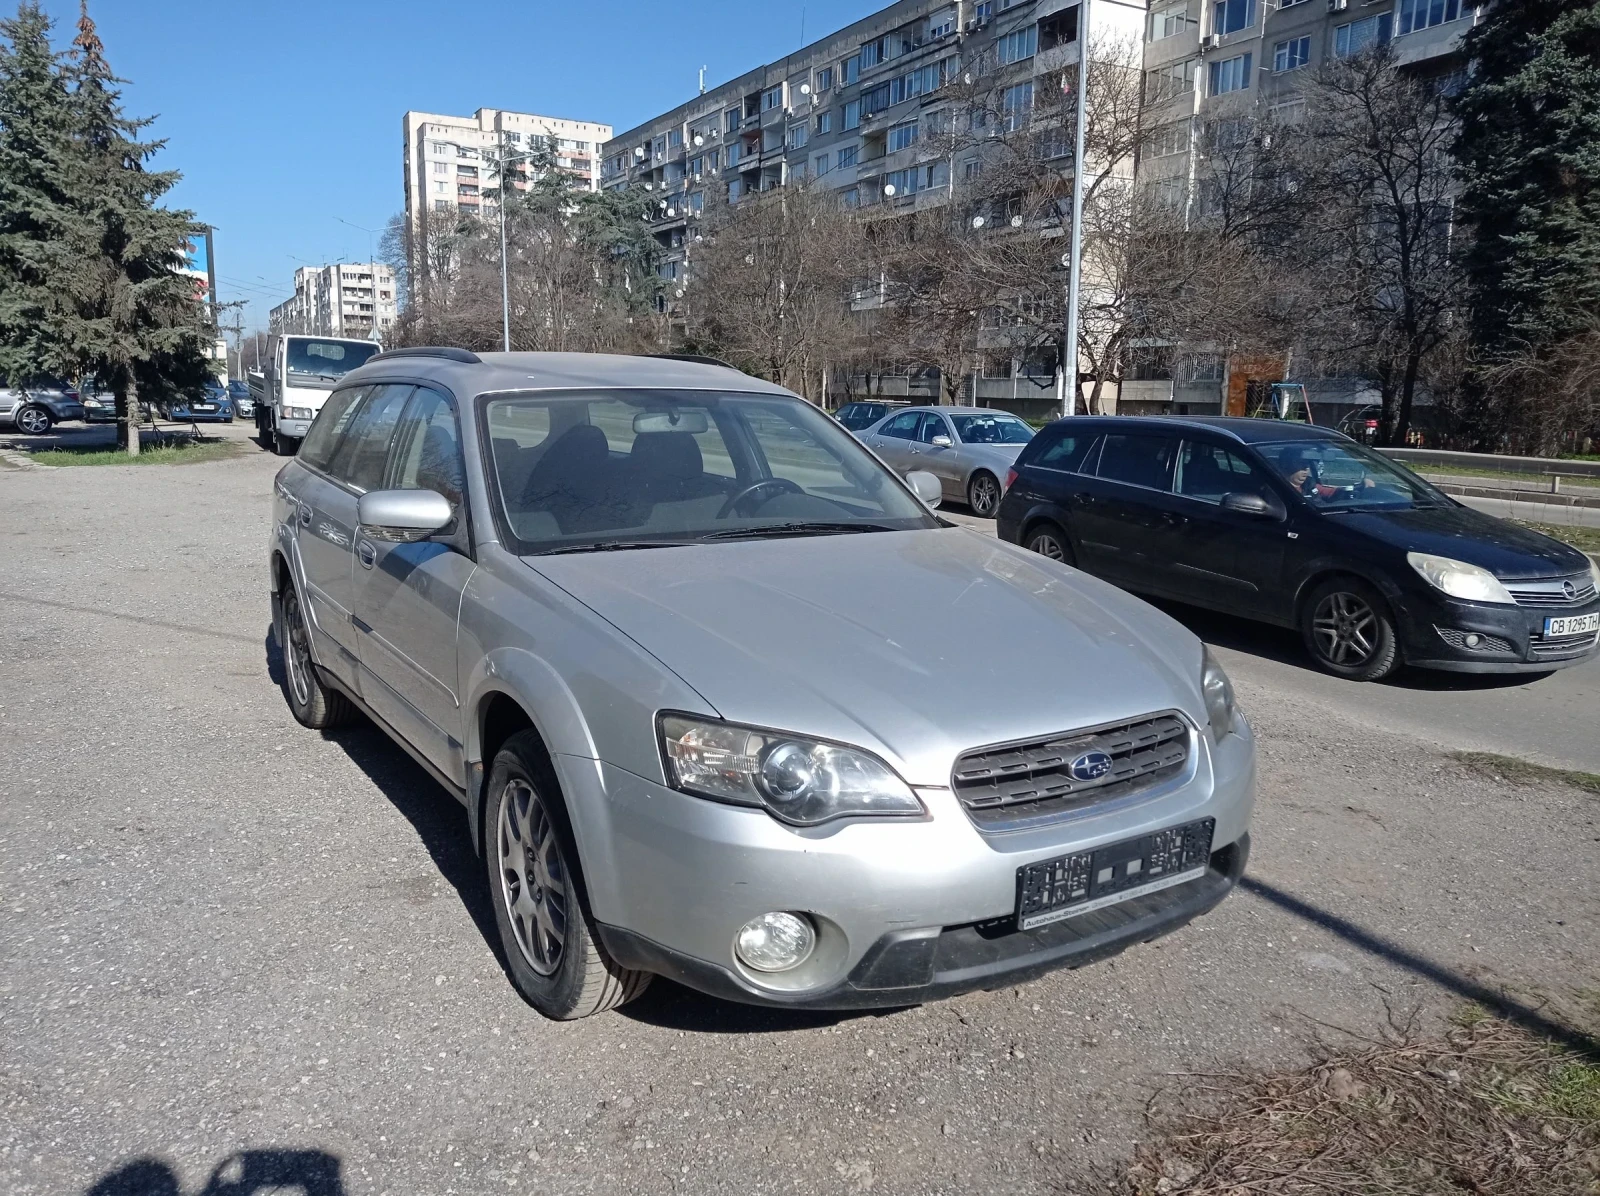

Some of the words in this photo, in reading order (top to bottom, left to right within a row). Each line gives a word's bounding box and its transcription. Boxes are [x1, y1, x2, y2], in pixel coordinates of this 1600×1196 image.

[1551, 619, 1565, 635] CB
[1567, 616, 1588, 633] 1295
[1588, 614, 1598, 630] TH
